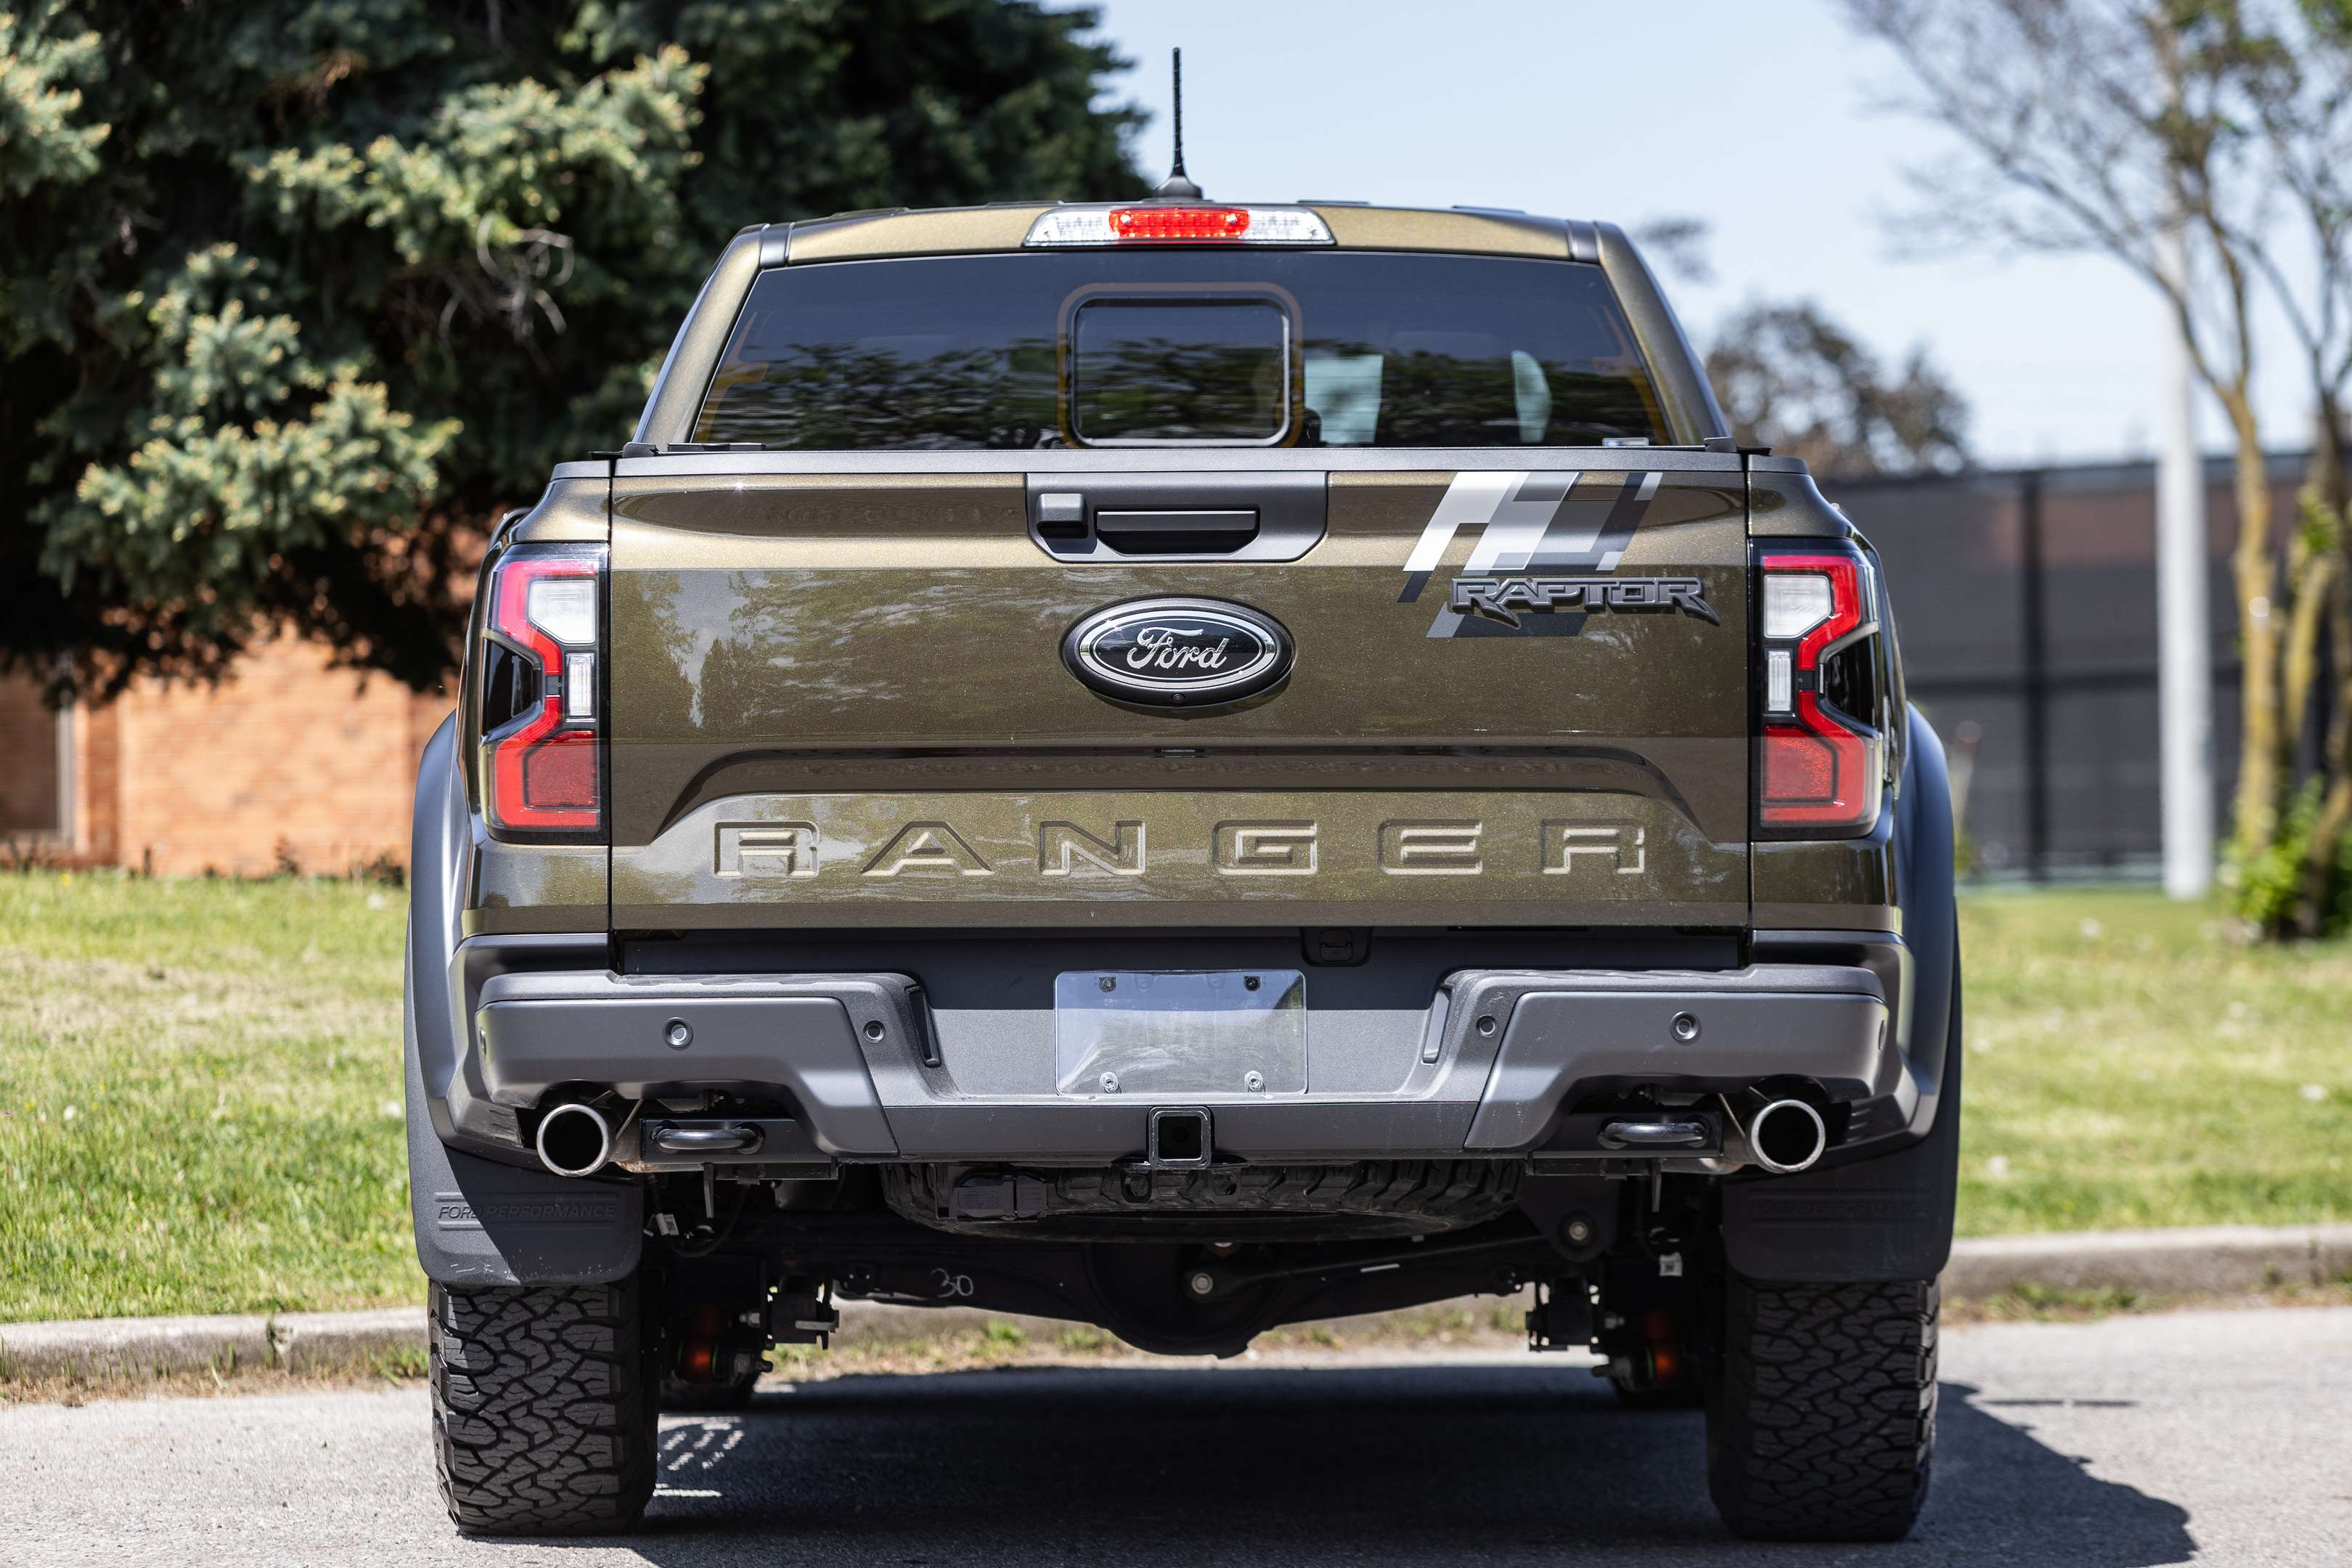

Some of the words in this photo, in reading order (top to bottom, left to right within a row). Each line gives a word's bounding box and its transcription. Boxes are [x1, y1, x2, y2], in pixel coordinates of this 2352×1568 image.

[1452, 577, 1720, 627] RAPTOR
[1127, 626, 1230, 669] Ford
[714, 820, 1645, 877] RANGER
[438, 1206, 482, 1220] FORD
[487, 1204, 616, 1220] PERFORMANCE
[930, 1267, 973, 1298] 30
